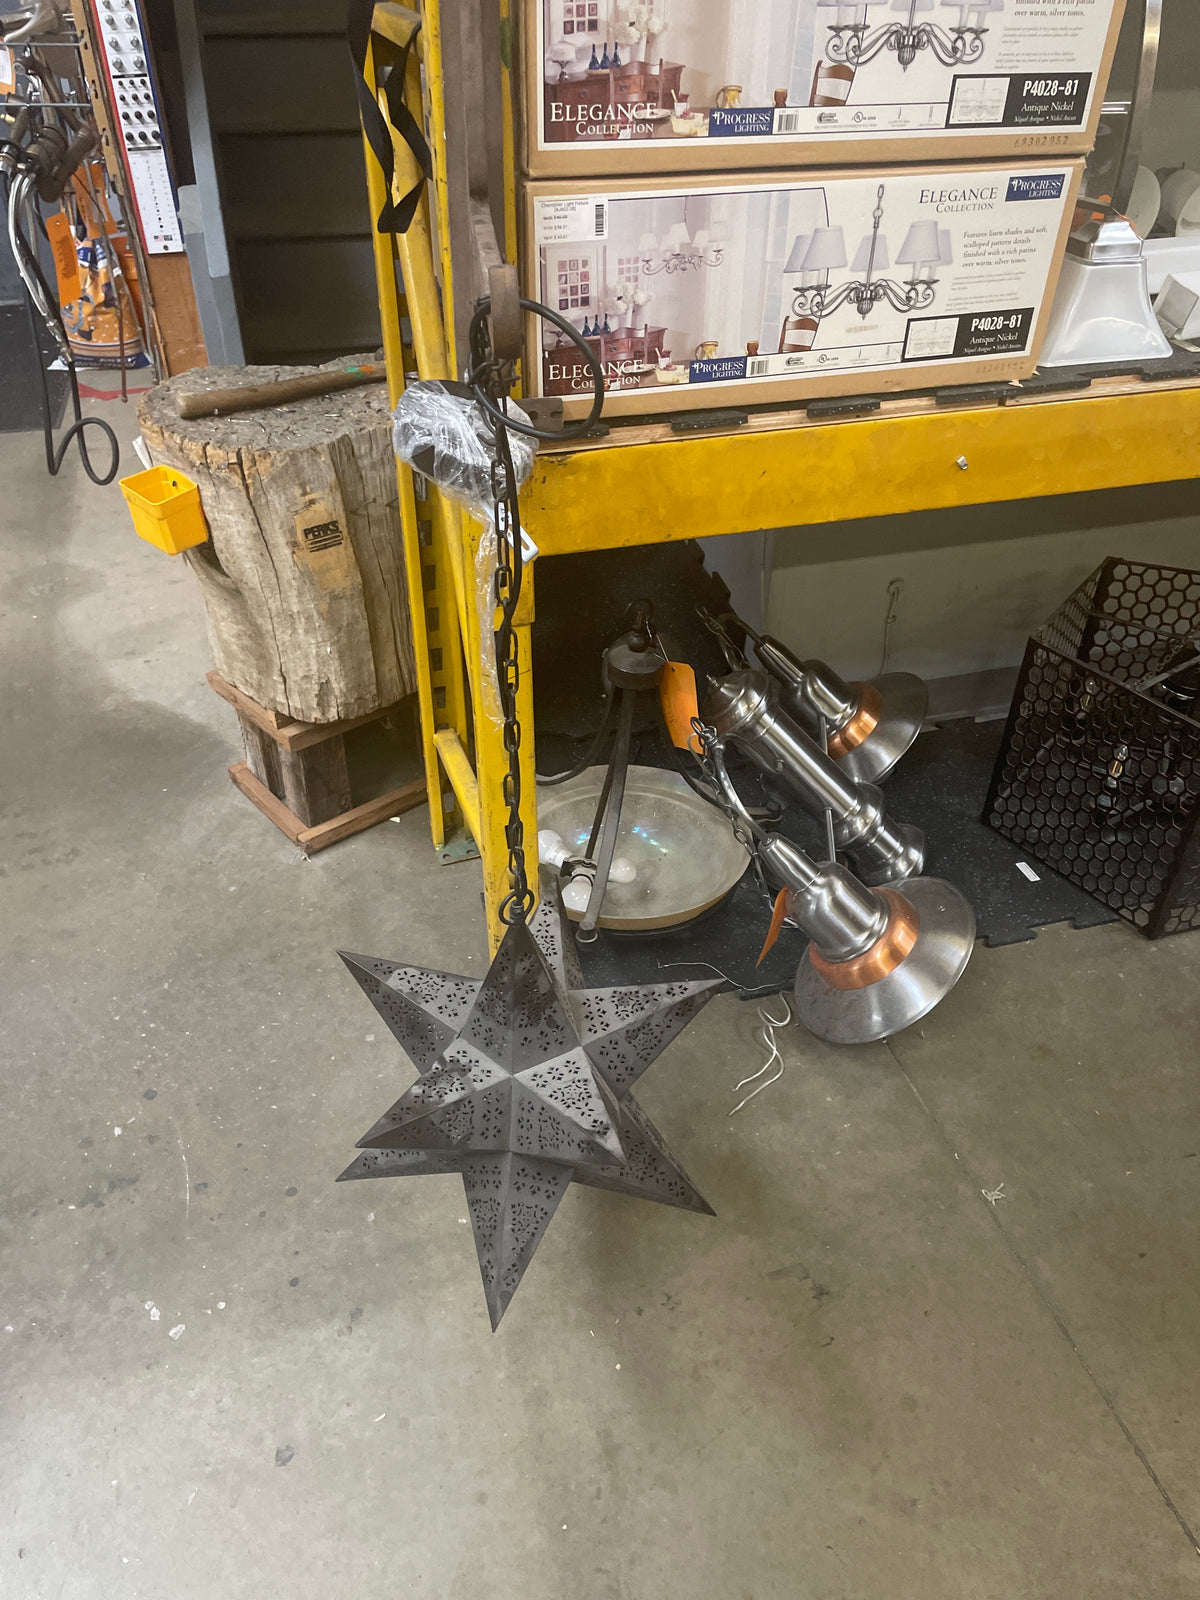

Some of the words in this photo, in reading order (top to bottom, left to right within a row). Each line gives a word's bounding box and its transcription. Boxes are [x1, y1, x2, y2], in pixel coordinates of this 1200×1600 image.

[1049, 8, 1065, 16] silver
[1022, 79, 1079, 97] P4028-81
[550, 102, 657, 122] ELEGANCE
[1020, 103, 1050, 114] Antique
[1050, 101, 1074, 112] Nickel
[715, 110, 772, 126] PROGRESS
[575, 121, 654, 136] COLLECTION
[734, 124, 769, 134] LIGHTING
[1013, 178, 1062, 192] PROGRESS
[919, 187, 999, 204] ELEGANCE
[1028, 190, 1059, 198] LIGHTING
[936, 203, 994, 214] COLLECTION
[963, 231, 987, 239] Features
[1004, 228, 1023, 236] shades
[963, 240, 990, 251] scalloped
[990, 240, 1012, 248] pattern
[1013, 238, 1031, 246] details
[963, 250, 986, 258] finished
[987, 249, 1001, 257] with
[1018, 247, 1036, 256] patina
[970, 314, 1022, 332] P4028-81
[969, 334, 995, 346] Antique
[996, 332, 1019, 342] Nickel
[694, 360, 744, 374] PROGRESS
[712, 369, 743, 379] LIGHTING
[571, 375, 641, 389] COLECTION
